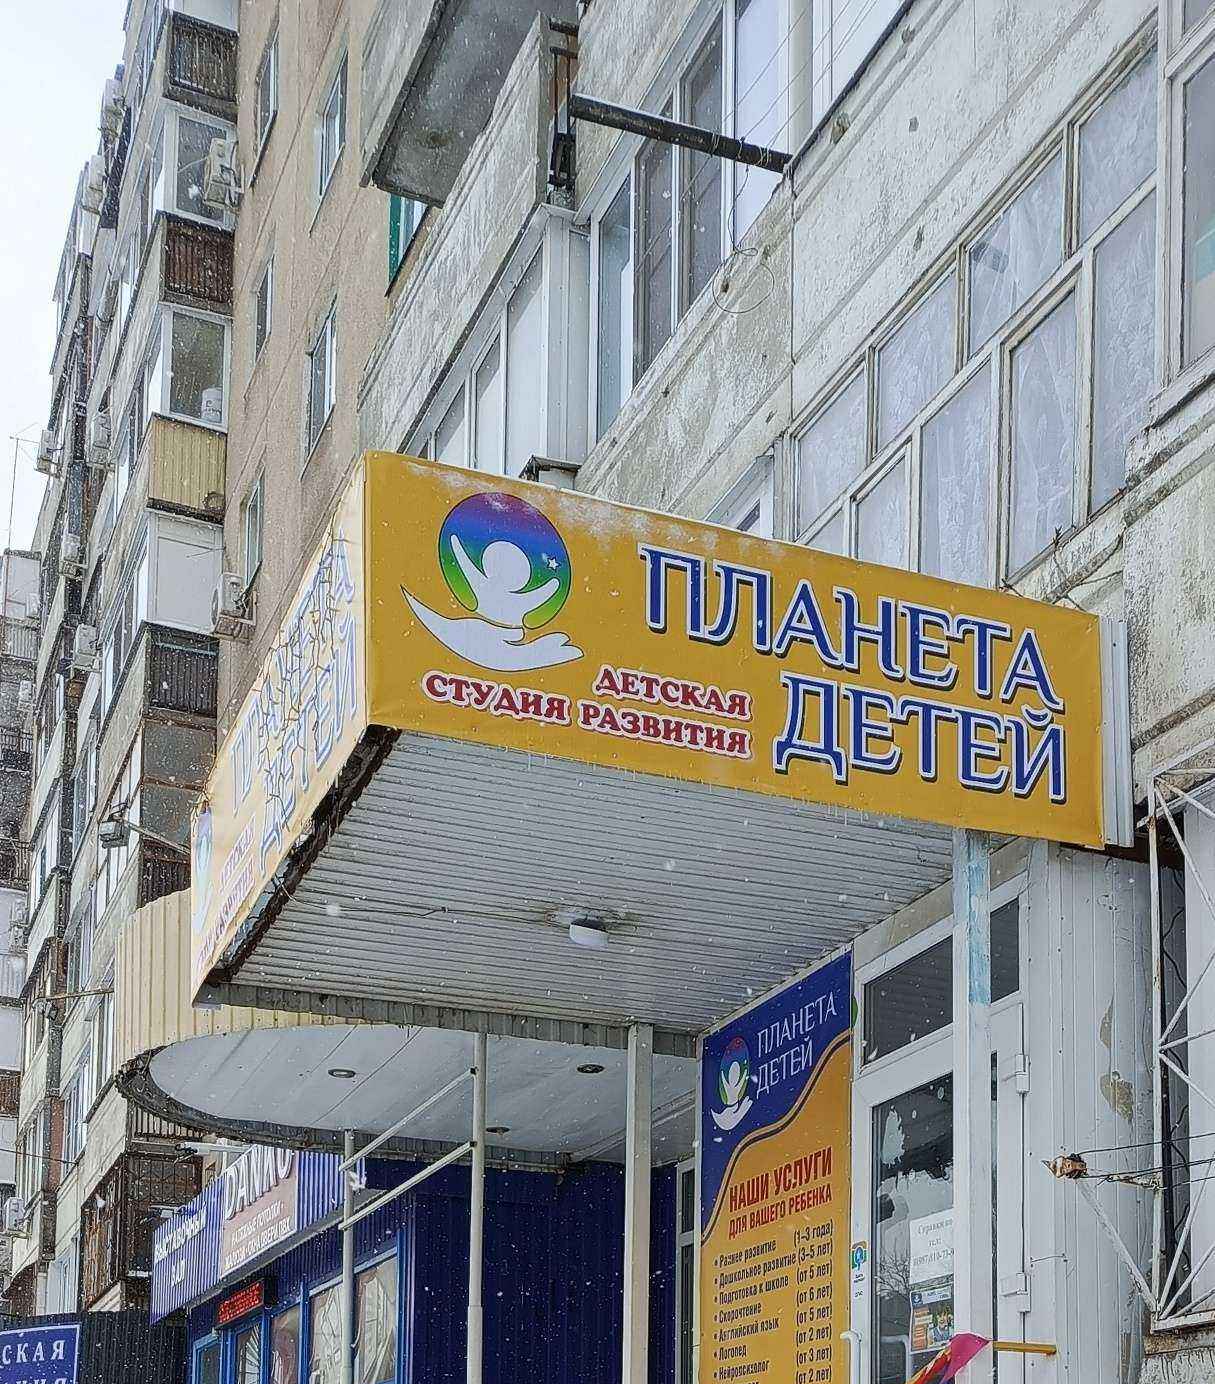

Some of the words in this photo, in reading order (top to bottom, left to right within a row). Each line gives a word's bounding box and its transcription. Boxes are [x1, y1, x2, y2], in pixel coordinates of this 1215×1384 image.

[639, 544, 1064, 710] ПЛАНЕТА
[595, 666, 751, 719] ДЕТСКАЯ
[424, 671, 570, 723] СТУДИЯ
[578, 701, 751, 758] РАЗВИТИЯ
[776, 671, 1066, 804] ДЕТЕЙ
[757, 991, 838, 1058] ПЛАНЕТА
[756, 1036, 813, 1099] ДЕТЕЙ
[729, 1173, 769, 1212] НАШИ
[774, 1146, 832, 1195] УСЛУГИ
[729, 1214, 747, 1240] ДЛЯ
[749, 1200, 786, 1230] ВАШЕГО
[788, 1183, 832, 1215] РЕБЕНКА
[817, 1238, 833, 1257] лет)
[816, 1259, 833, 1276] лет)
[816, 1281, 833, 1298] лет)
[796, 1311, 807, 1328] (от
[809, 1307, 814, 1322] 5
[816, 1302, 833, 1319] лет)
[1, 1340, 65, 1365] СКАЯ
[796, 1331, 807, 1348] (от
[809, 1328, 814, 1342] 2
[815, 1324, 833, 1342] лет)
[796, 1350, 807, 1366] (от
[809, 1347, 815, 1362] 3
[815, 1344, 833, 1361] лет)
[809, 1369, 814, 1383] 2
[815, 1365, 833, 1382] лет)
